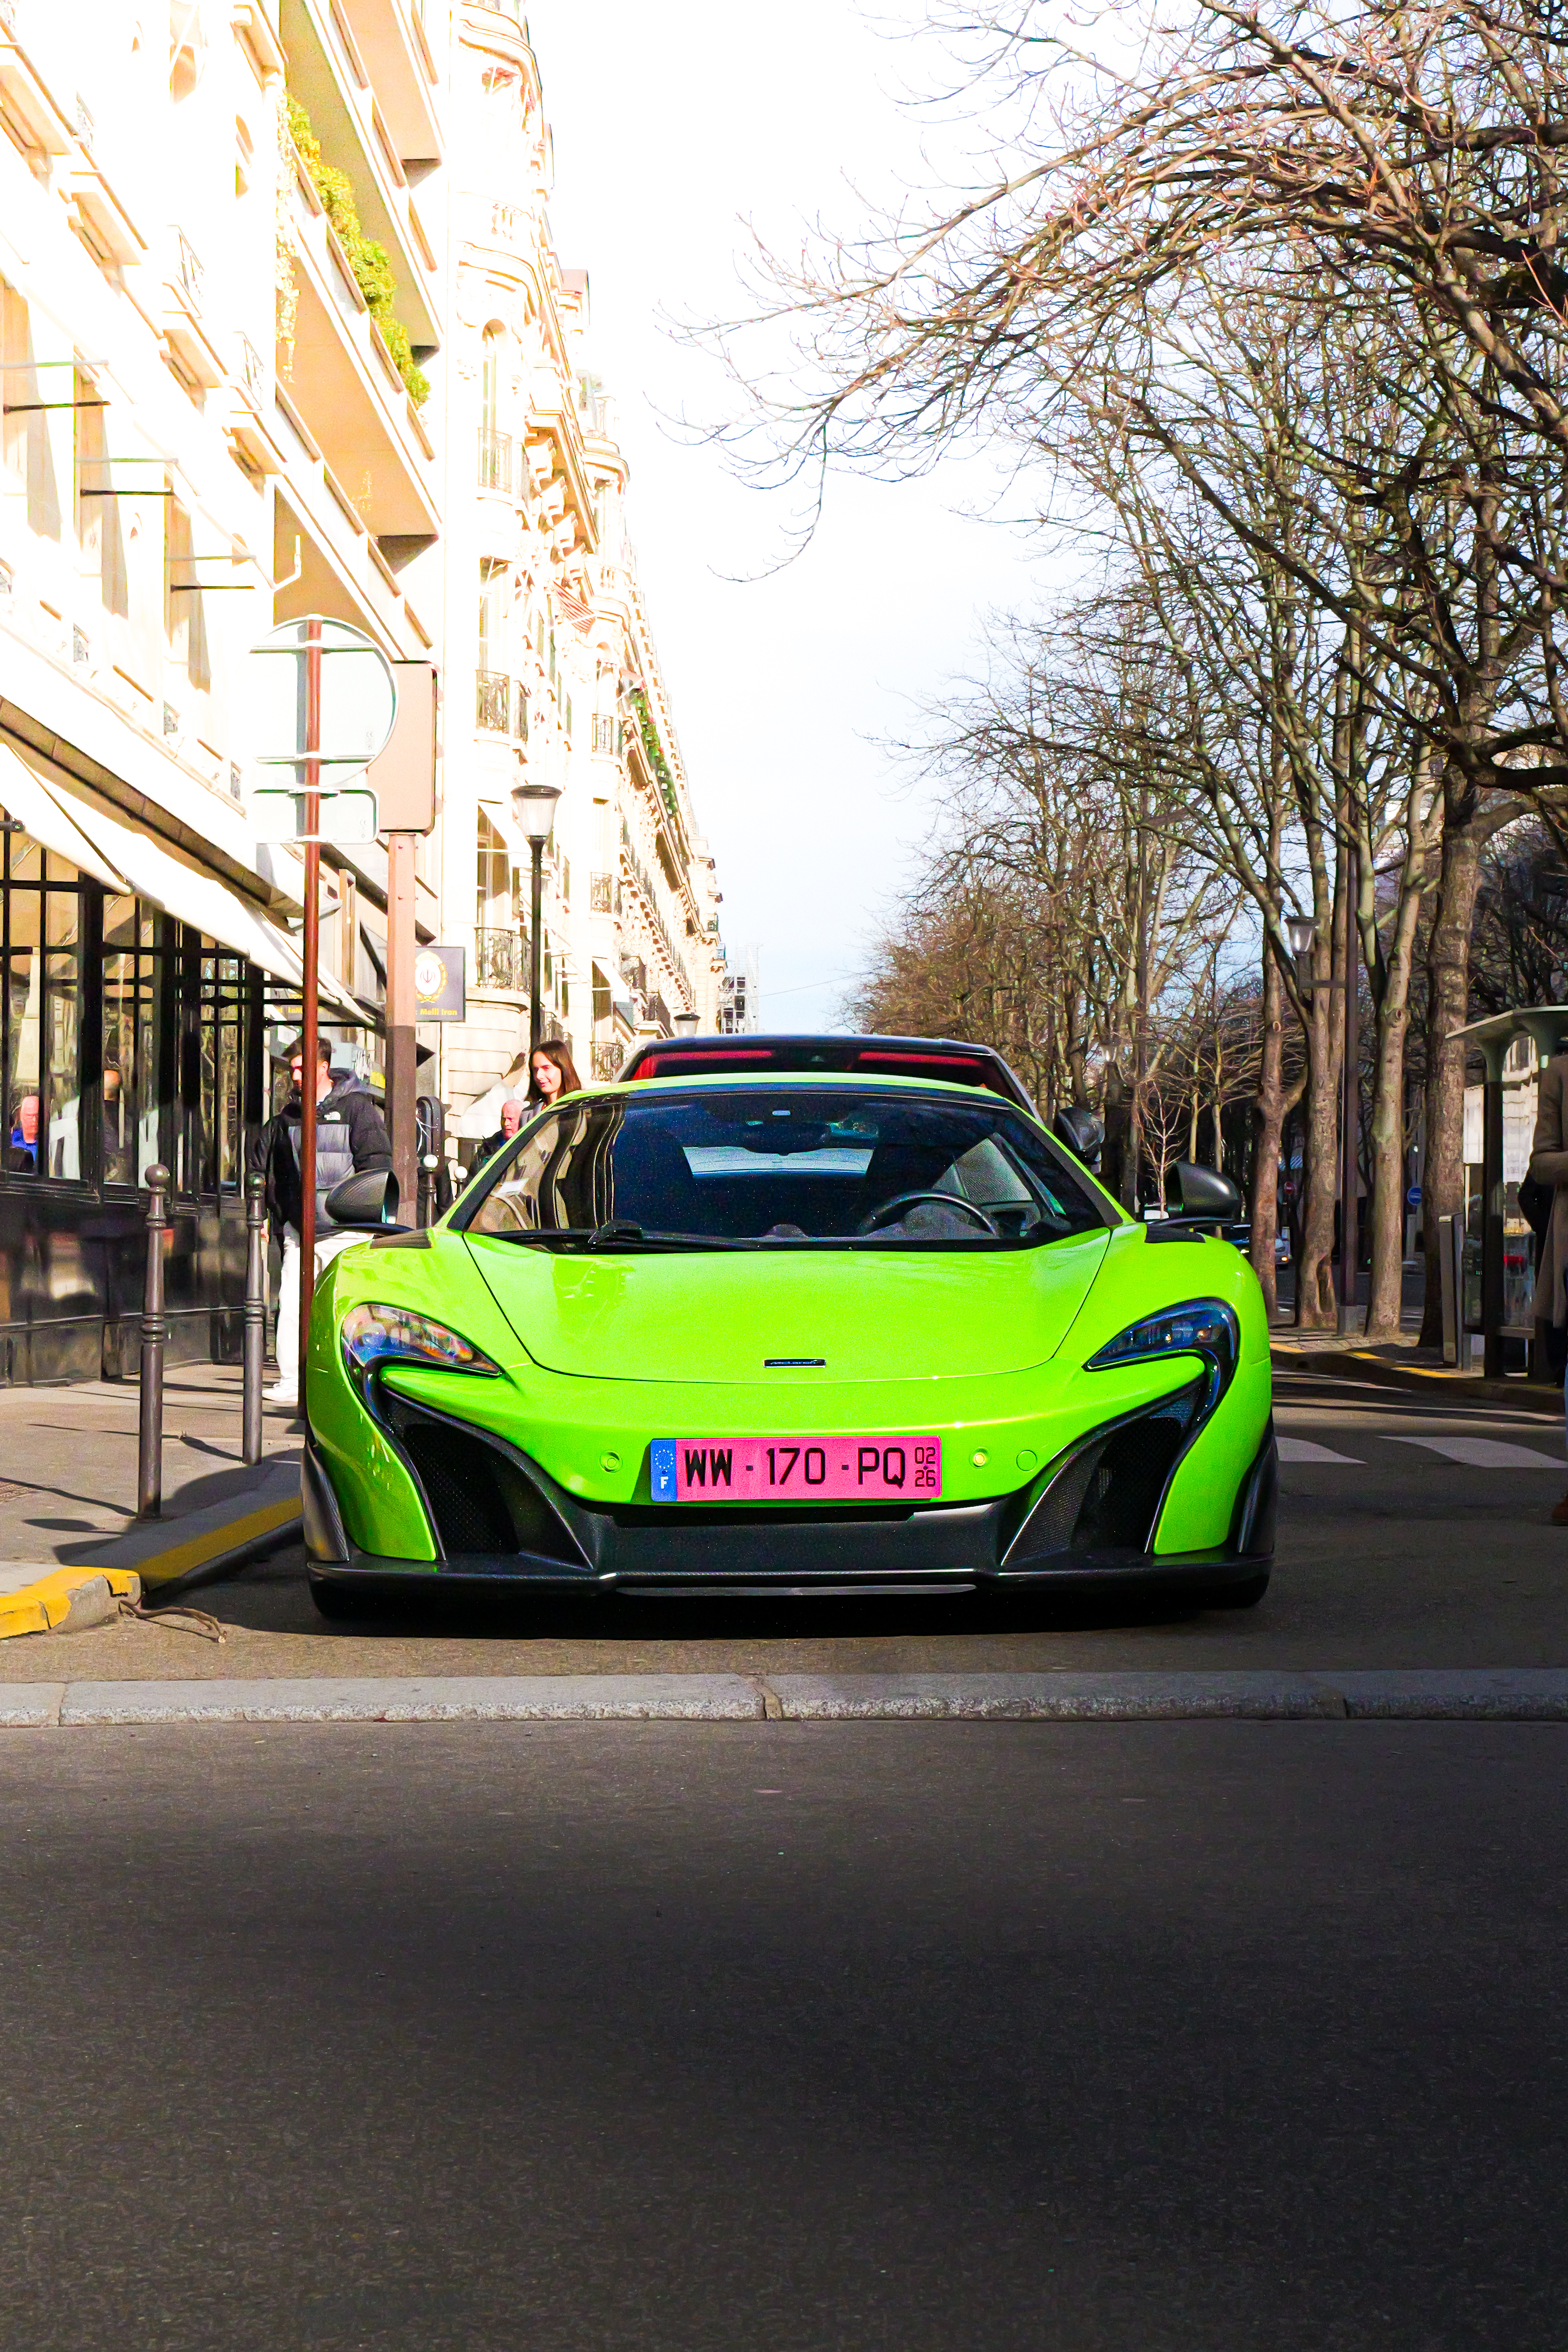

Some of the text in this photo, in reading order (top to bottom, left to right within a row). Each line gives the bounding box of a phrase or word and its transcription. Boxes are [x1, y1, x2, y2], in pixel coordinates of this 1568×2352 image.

[915, 1447, 936, 1464] 02
[685, 1449, 733, 1487] WW
[766, 1447, 826, 1486] 170
[858, 1447, 905, 1490] PQ
[661, 1476, 669, 1489] F
[915, 1469, 936, 1487] 26
